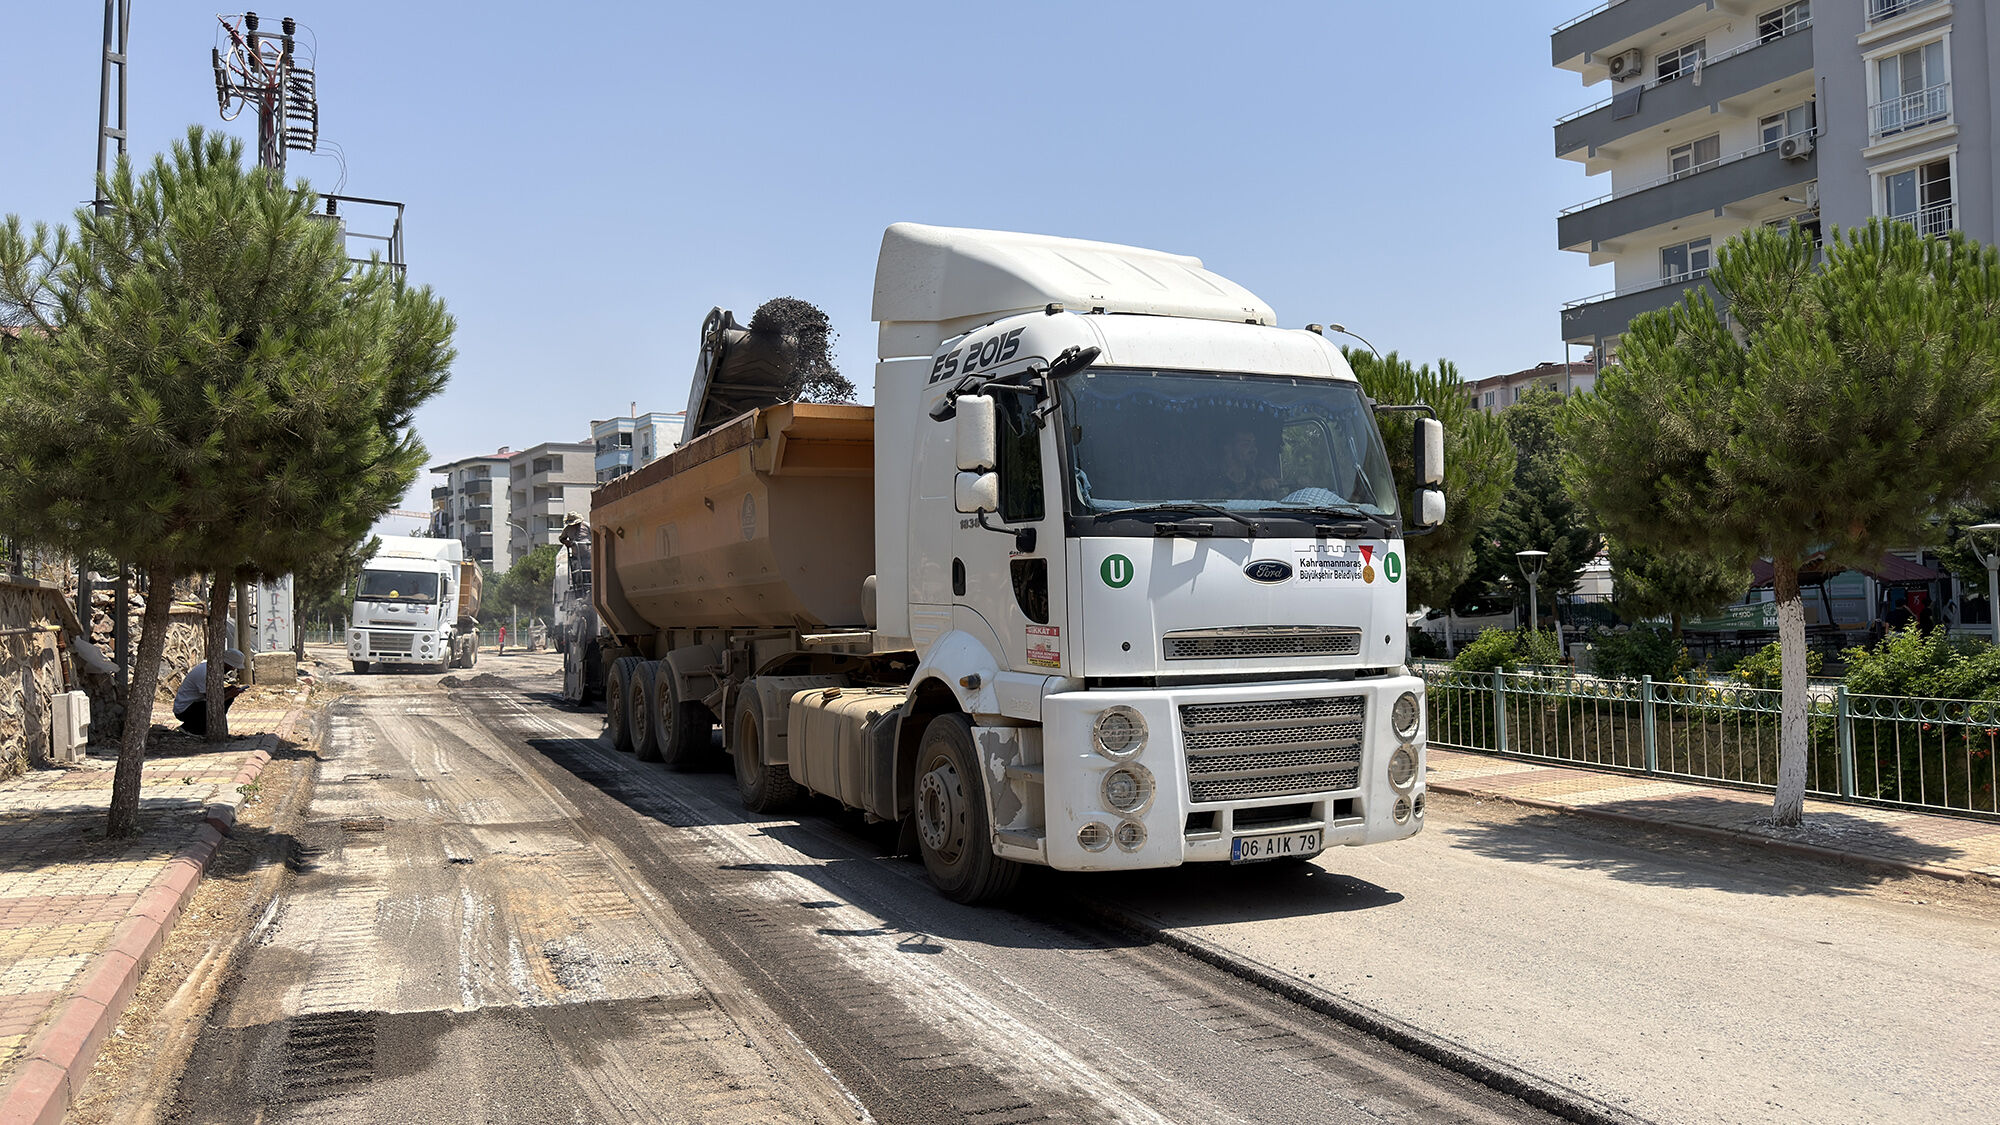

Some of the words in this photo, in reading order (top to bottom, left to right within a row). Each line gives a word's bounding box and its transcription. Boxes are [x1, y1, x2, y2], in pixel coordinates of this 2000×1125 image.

[929, 348, 963, 384] ES
[962, 326, 1027, 374] 2015
[1109, 559, 1125, 583] U
[1256, 564, 1284, 577] Ford
[1300, 558, 1362, 570] Kahramanmaraş
[1388, 557, 1399, 578] L
[1300, 570, 1333, 582] Büyükşehir
[1333, 568, 1363, 582] Belediyesi
[1242, 840, 1259, 857] 06
[1266, 837, 1292, 854] AIK
[1300, 834, 1316, 851] 79
